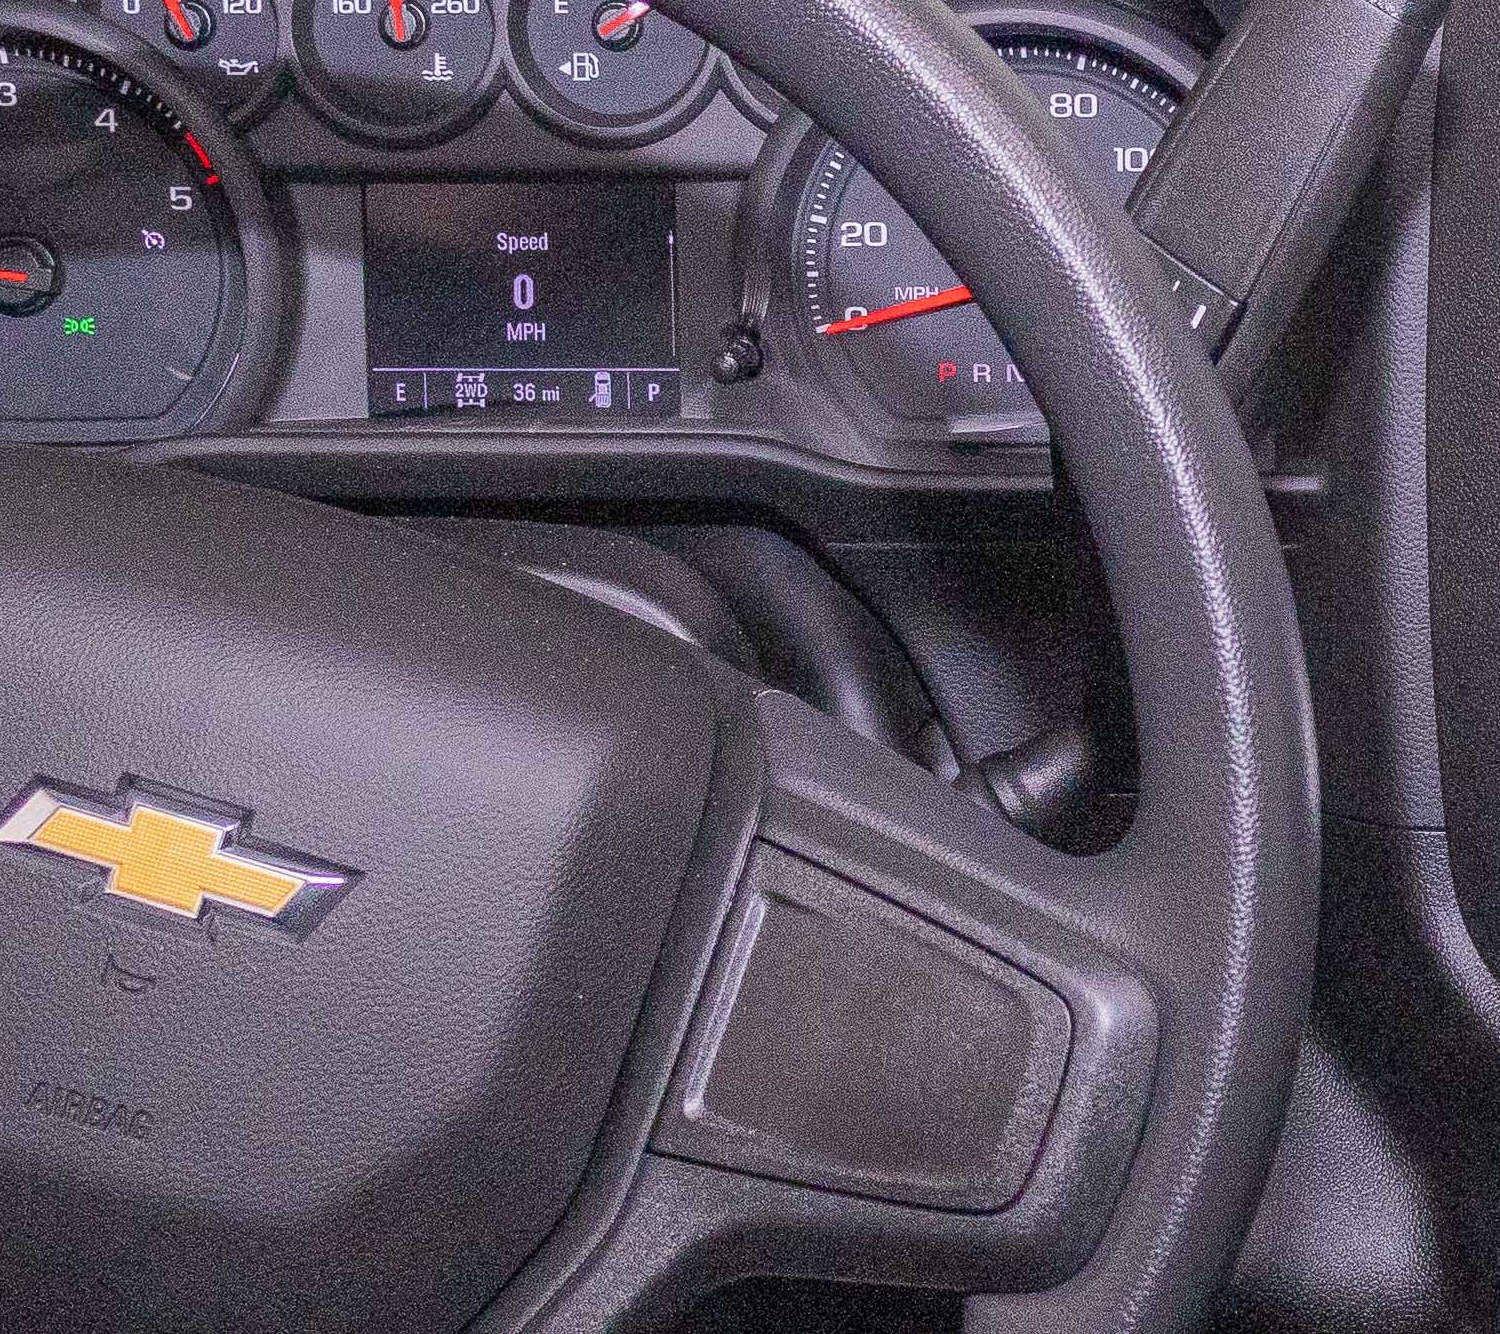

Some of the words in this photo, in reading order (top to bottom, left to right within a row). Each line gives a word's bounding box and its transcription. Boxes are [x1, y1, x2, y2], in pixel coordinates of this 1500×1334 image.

[1049, 93, 1098, 117] 80
[94, 108, 118, 133] 4
[1113, 147, 1156, 172] 10
[169, 186, 193, 211] 5
[496, 232, 548, 254] Speed
[840, 221, 888, 247] 20
[512, 273, 534, 310] 0
[506, 322, 546, 342] MPH
[938, 361, 958, 383] P
[973, 363, 991, 383] R
[395, 383, 406, 402] E
[455, 383, 488, 399] 2WD
[513, 383, 536, 402] 36
[541, 385, 560, 402] mi
[647, 383, 660, 402] P
